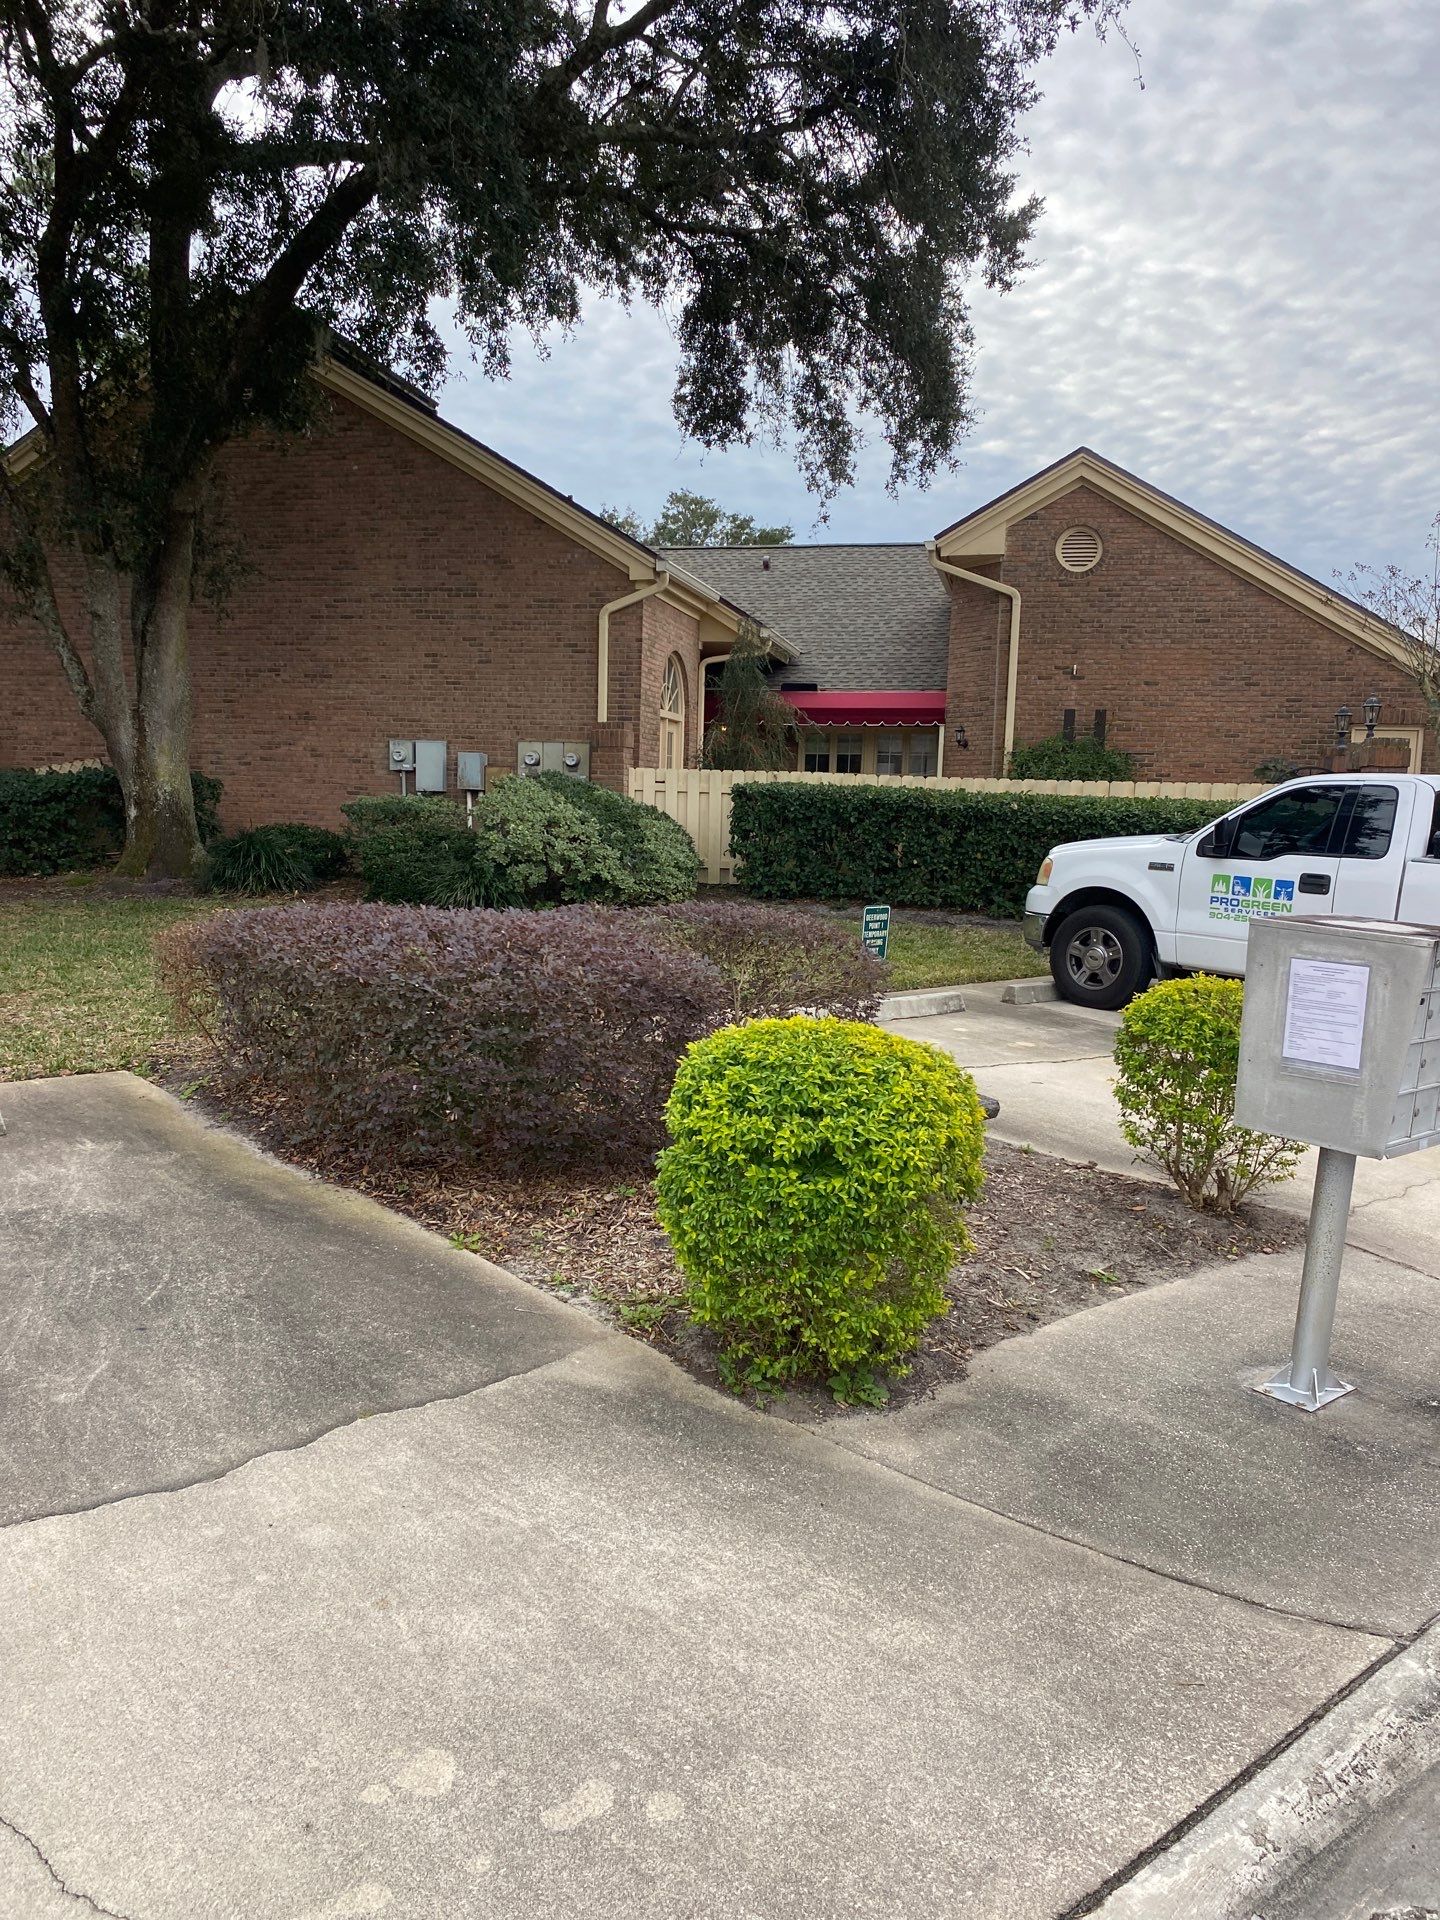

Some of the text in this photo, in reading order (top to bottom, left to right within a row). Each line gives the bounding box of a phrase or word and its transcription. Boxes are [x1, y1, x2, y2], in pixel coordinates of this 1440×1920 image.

[1210, 896, 1292, 913] PROGREEN
[1224, 907, 1276, 916] SERVICES
[1209, 912, 1250, 922] 904-25
